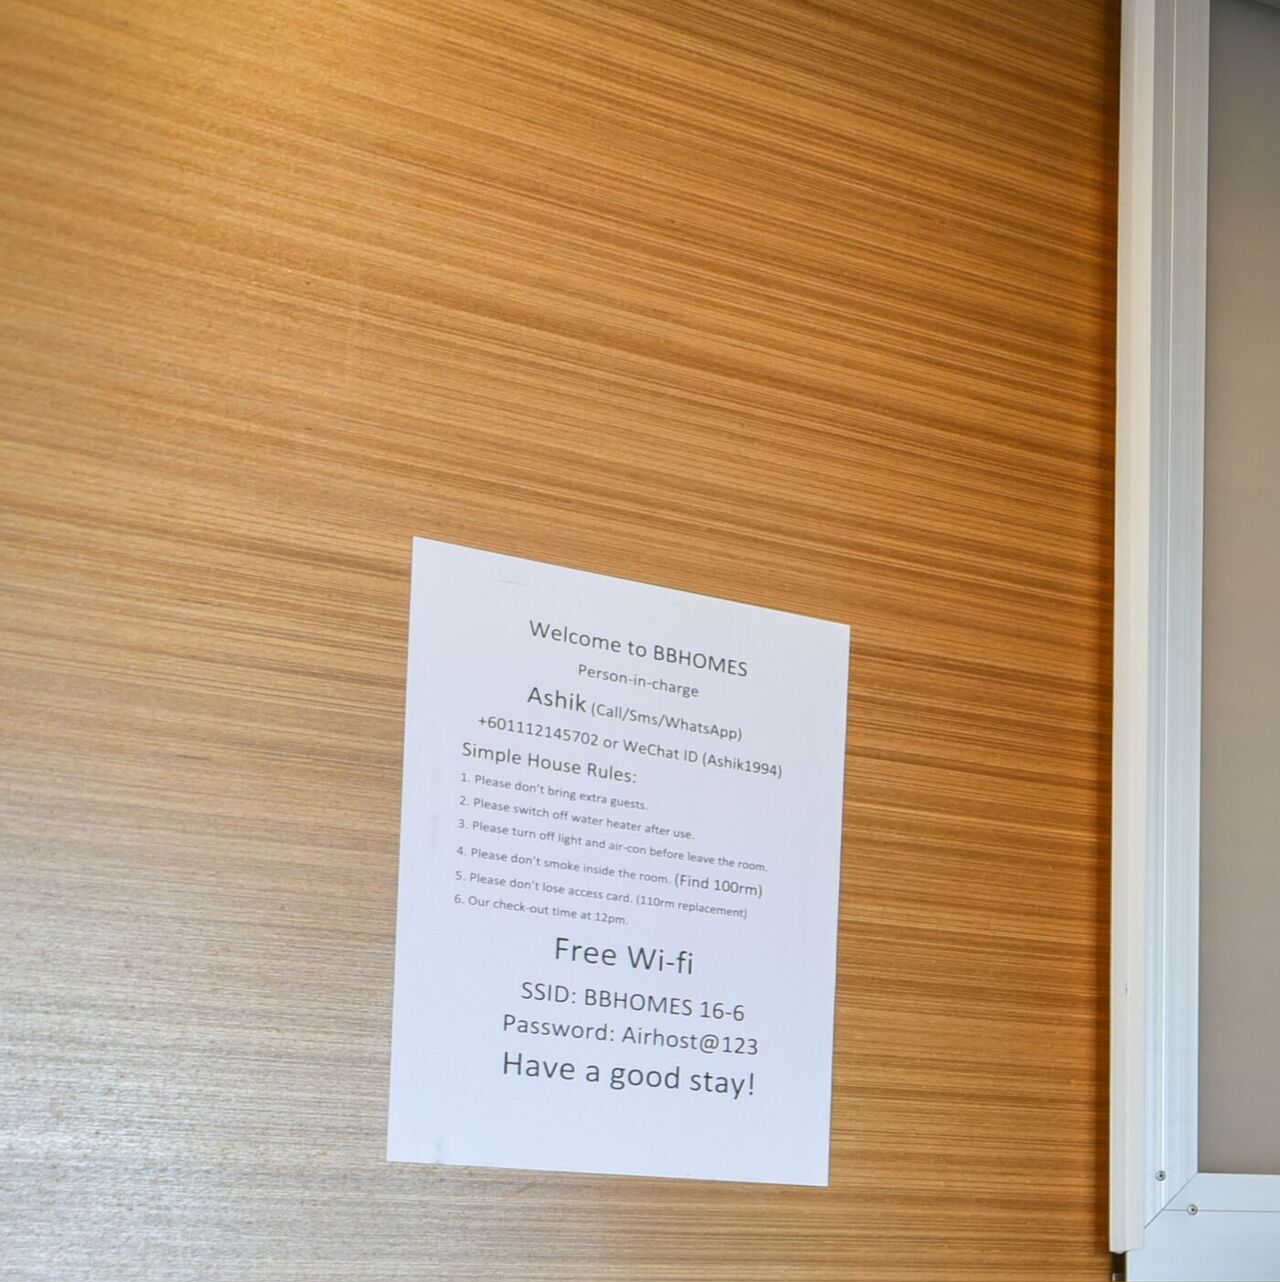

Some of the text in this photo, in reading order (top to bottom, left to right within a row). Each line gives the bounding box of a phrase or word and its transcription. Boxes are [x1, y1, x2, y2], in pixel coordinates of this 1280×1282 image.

[529, 619, 748, 678] Welcome to BBHOMES
[578, 663, 700, 699] Person-in-charge
[526, 686, 743, 743] Ashik (Call/Sms/WhatsApp)
[461, 741, 637, 784] Simple House Rules:
[477, 715, 783, 780] +601112145702 or WeChat ID (Ashik1994)
[461, 772, 471, 784] 1.
[474, 774, 512, 790] Please
[547, 785, 577, 802] bring
[579, 793, 608, 805] extra
[609, 798, 649, 811] guests.
[459, 795, 695, 840] 2. Please switch off water heater after use.
[458, 818, 768, 873] 3. Please turn off light and air-con before leave the room.
[455, 870, 466, 881] 5.
[469, 872, 507, 887] Please
[542, 882, 566, 895] lose
[567, 887, 604, 900] access
[606, 892, 633, 904] card.
[635, 894, 675, 909] (110rm
[677, 902, 748, 920] replacement)
[456, 845, 467, 856] 4.
[470, 847, 508, 862] Please
[543, 859, 581, 872] smoke
[583, 864, 616, 877] inside
[618, 868, 637, 880] the
[639, 873, 671, 885] room.
[674, 872, 710, 890] (Find
[713, 879, 763, 900] 100rm)
[454, 893, 629, 925] 6. Our check-out time at 12pm.
[554, 936, 693, 976] Free Wi-fi
[520, 981, 745, 1022] SSID: BBHOMES 16-6
[503, 1013, 758, 1056] Password: Airhost@123
[503, 1051, 755, 1101] Have a good stay!
